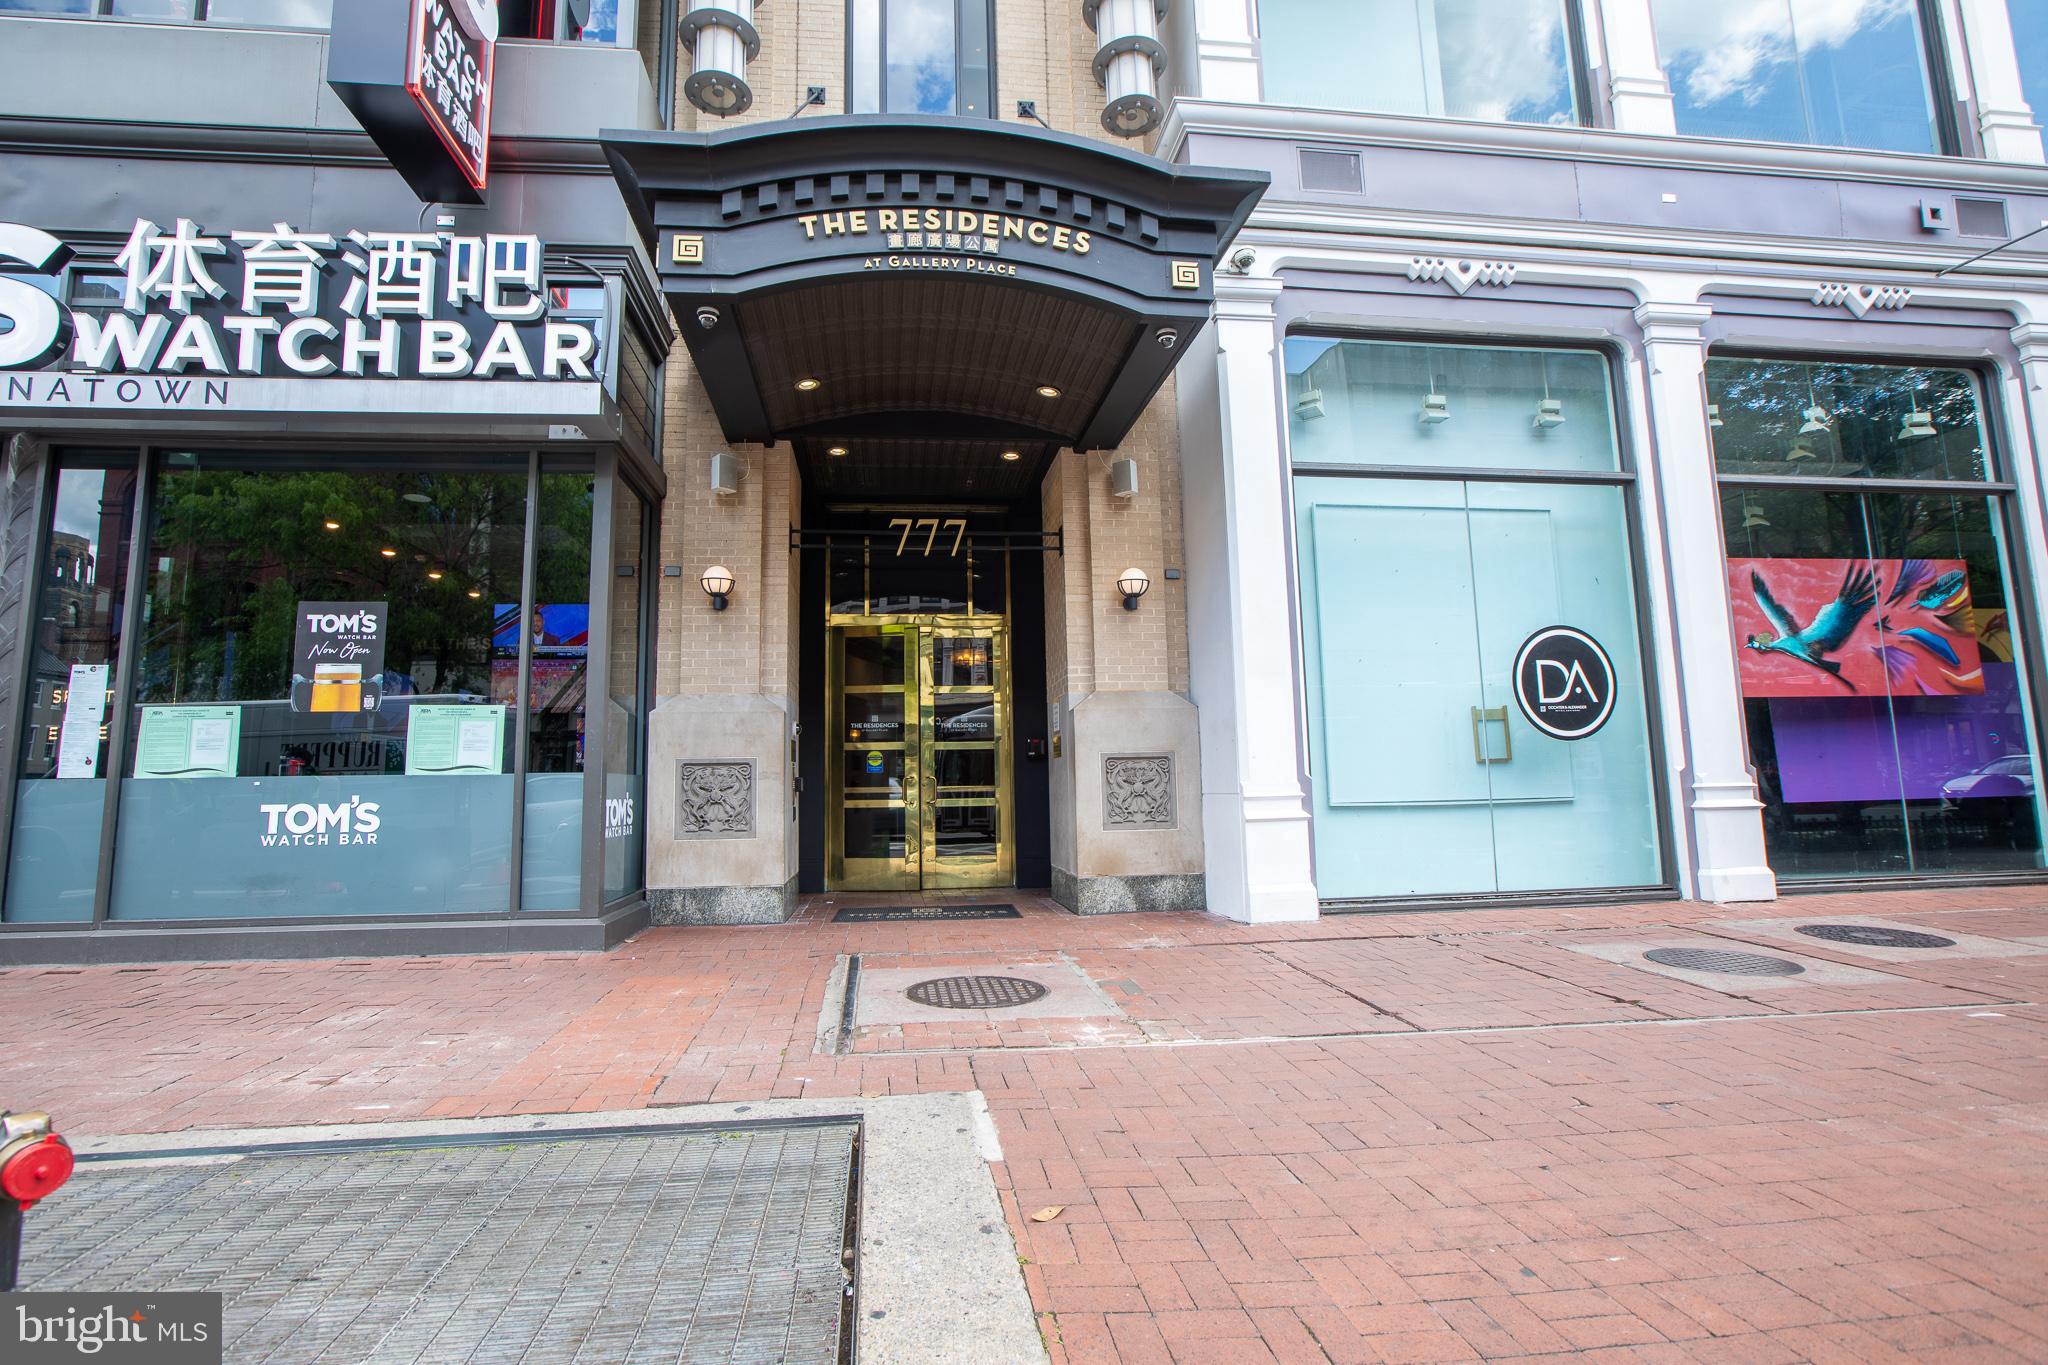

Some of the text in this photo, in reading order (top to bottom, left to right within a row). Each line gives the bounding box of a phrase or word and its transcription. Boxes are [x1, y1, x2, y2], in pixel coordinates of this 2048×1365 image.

[434, 31, 472, 112] BAR
[799, 208, 1091, 255] THE RESIDENCES
[114, 217, 545, 321] 体育酒吧
[863, 257, 881, 269] AT
[72, 312, 597, 380] WATCH BAR
[8, 375, 229, 405] NATOWN
[888, 518, 967, 557] 777
[306, 610, 377, 633] TOM'S
[307, 641, 371, 660] Now Open
[260, 795, 381, 834] TOM'S
[605, 792, 634, 826] TOM'S
[260, 833, 378, 847] WATCH BAR
